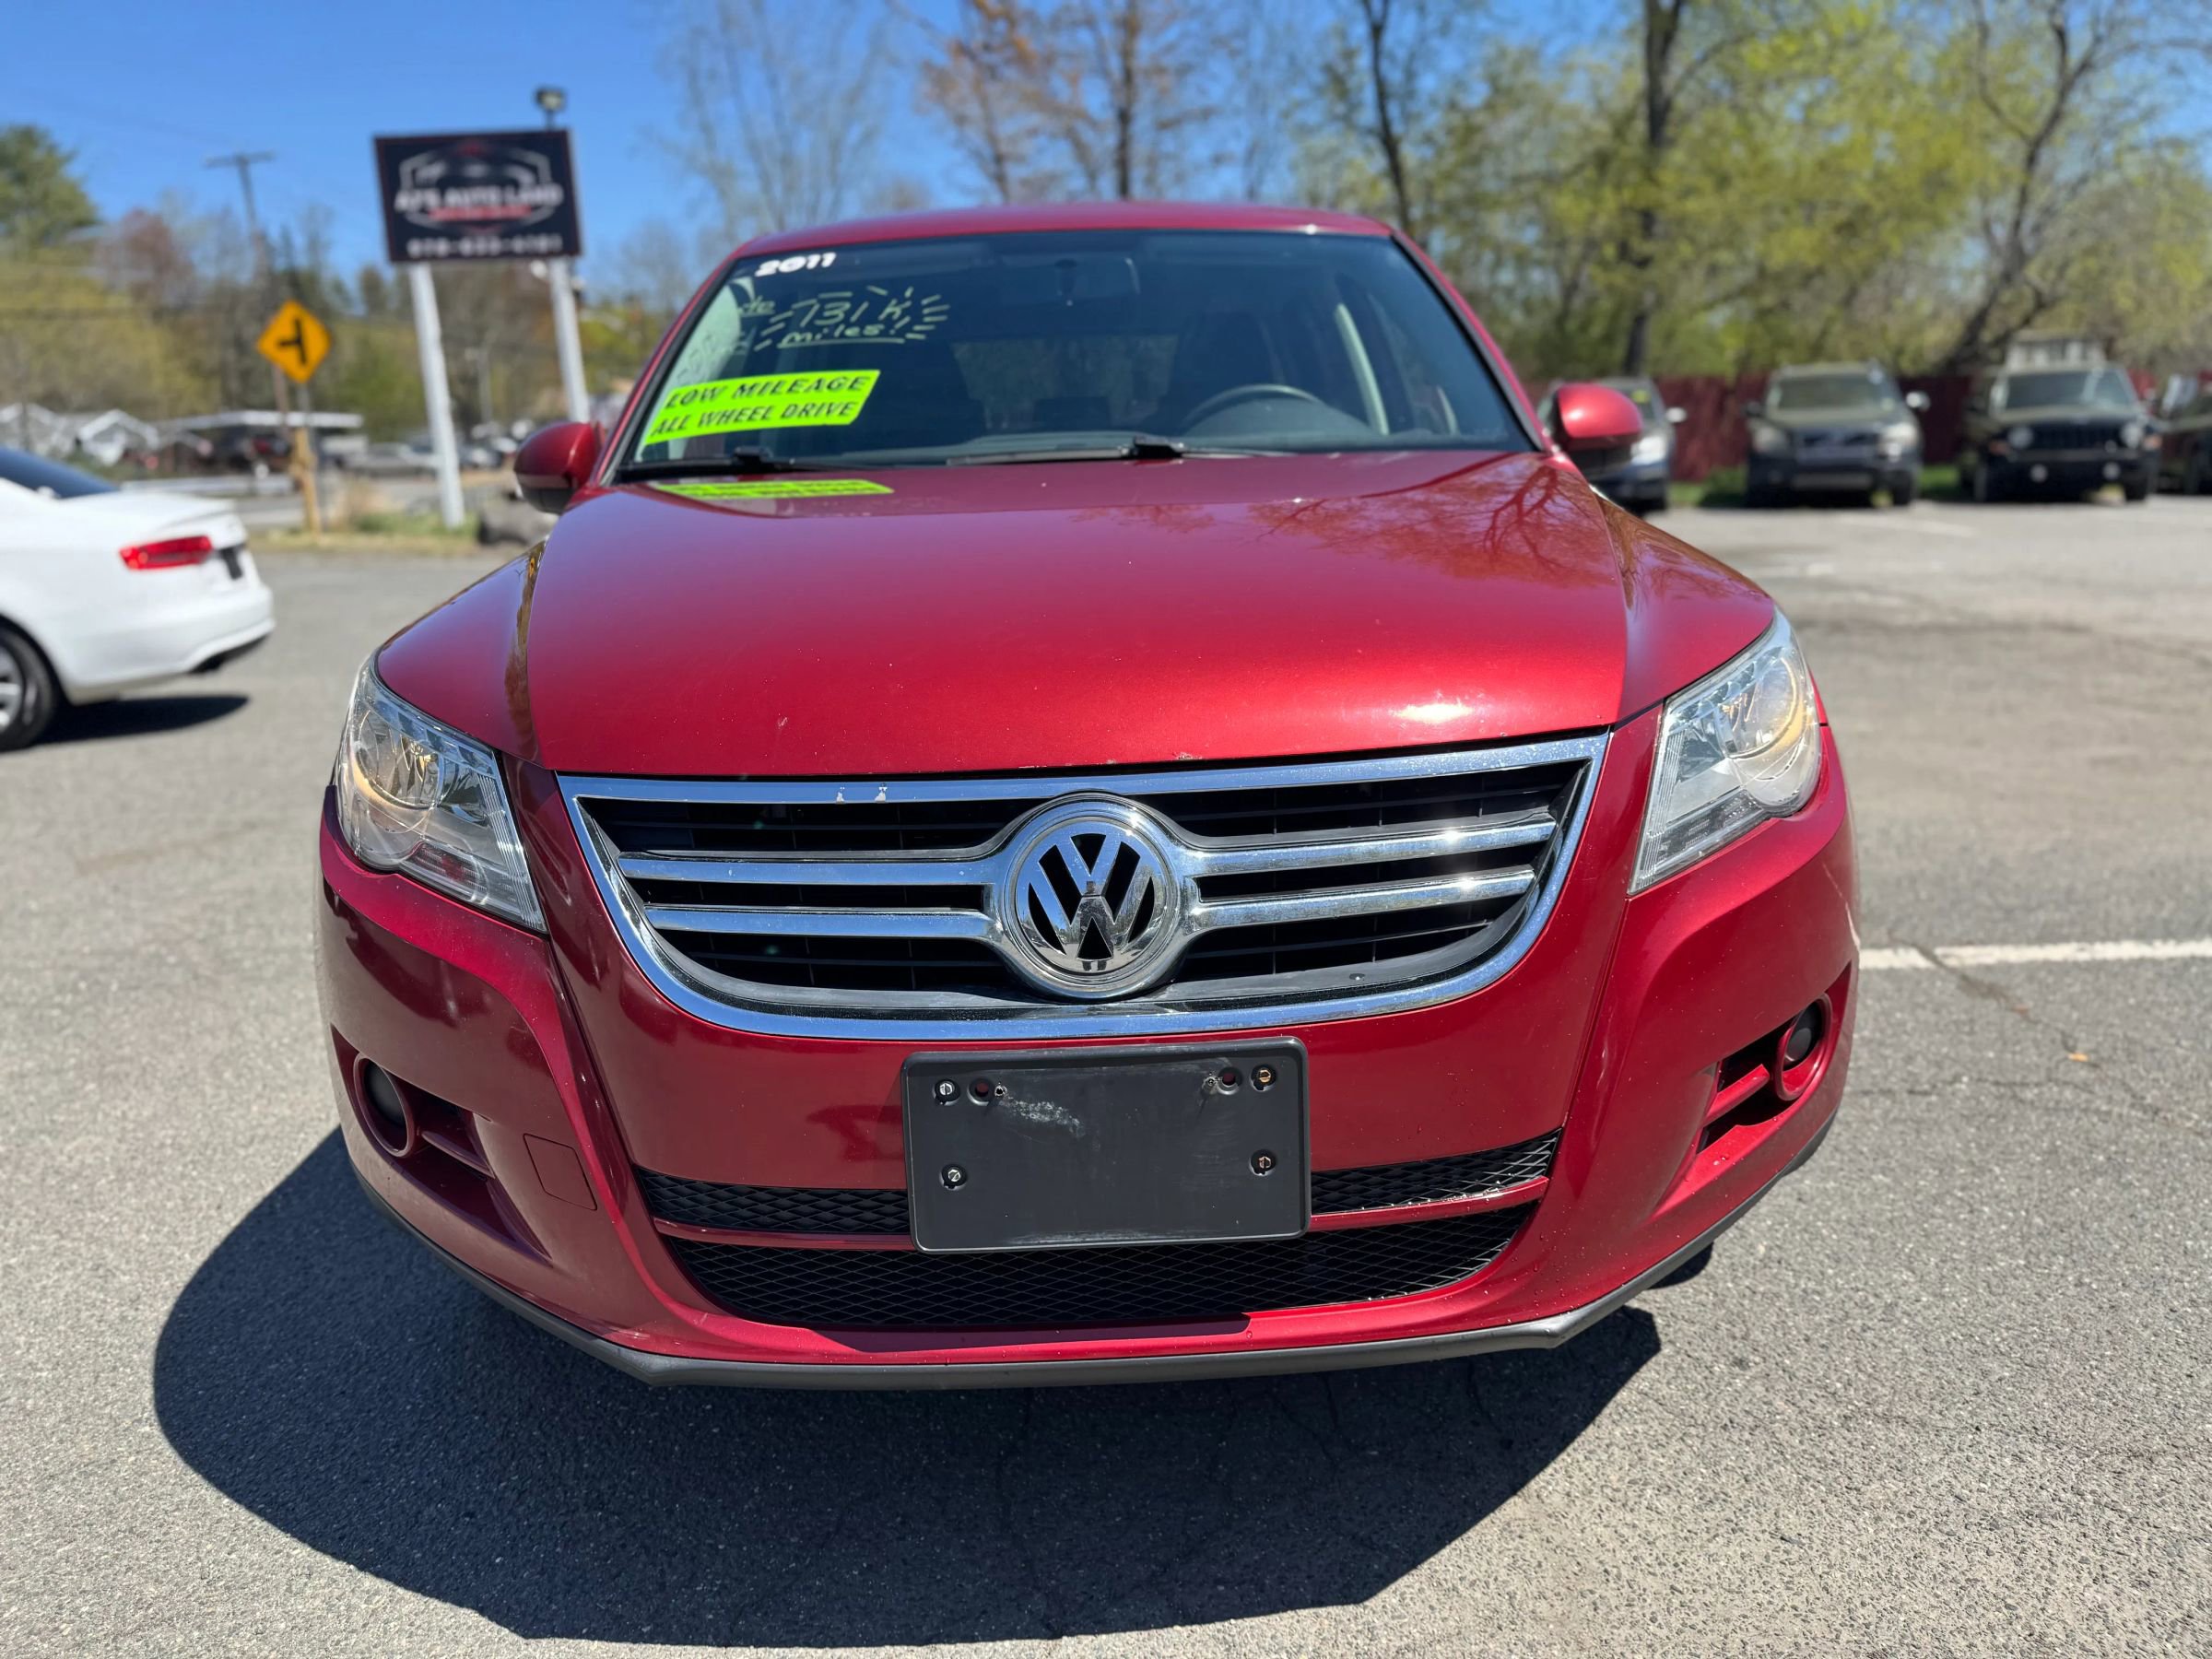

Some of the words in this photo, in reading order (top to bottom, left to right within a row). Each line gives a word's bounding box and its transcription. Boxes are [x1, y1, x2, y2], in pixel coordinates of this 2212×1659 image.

[755, 253, 836, 276] 2011
[665, 386, 726, 408] LOW
[731, 376, 871, 399] MILEAGE
[651, 415, 691, 437] ALL
[698, 405, 776, 428] WHEEL
[781, 401, 859, 419] DRIVE
